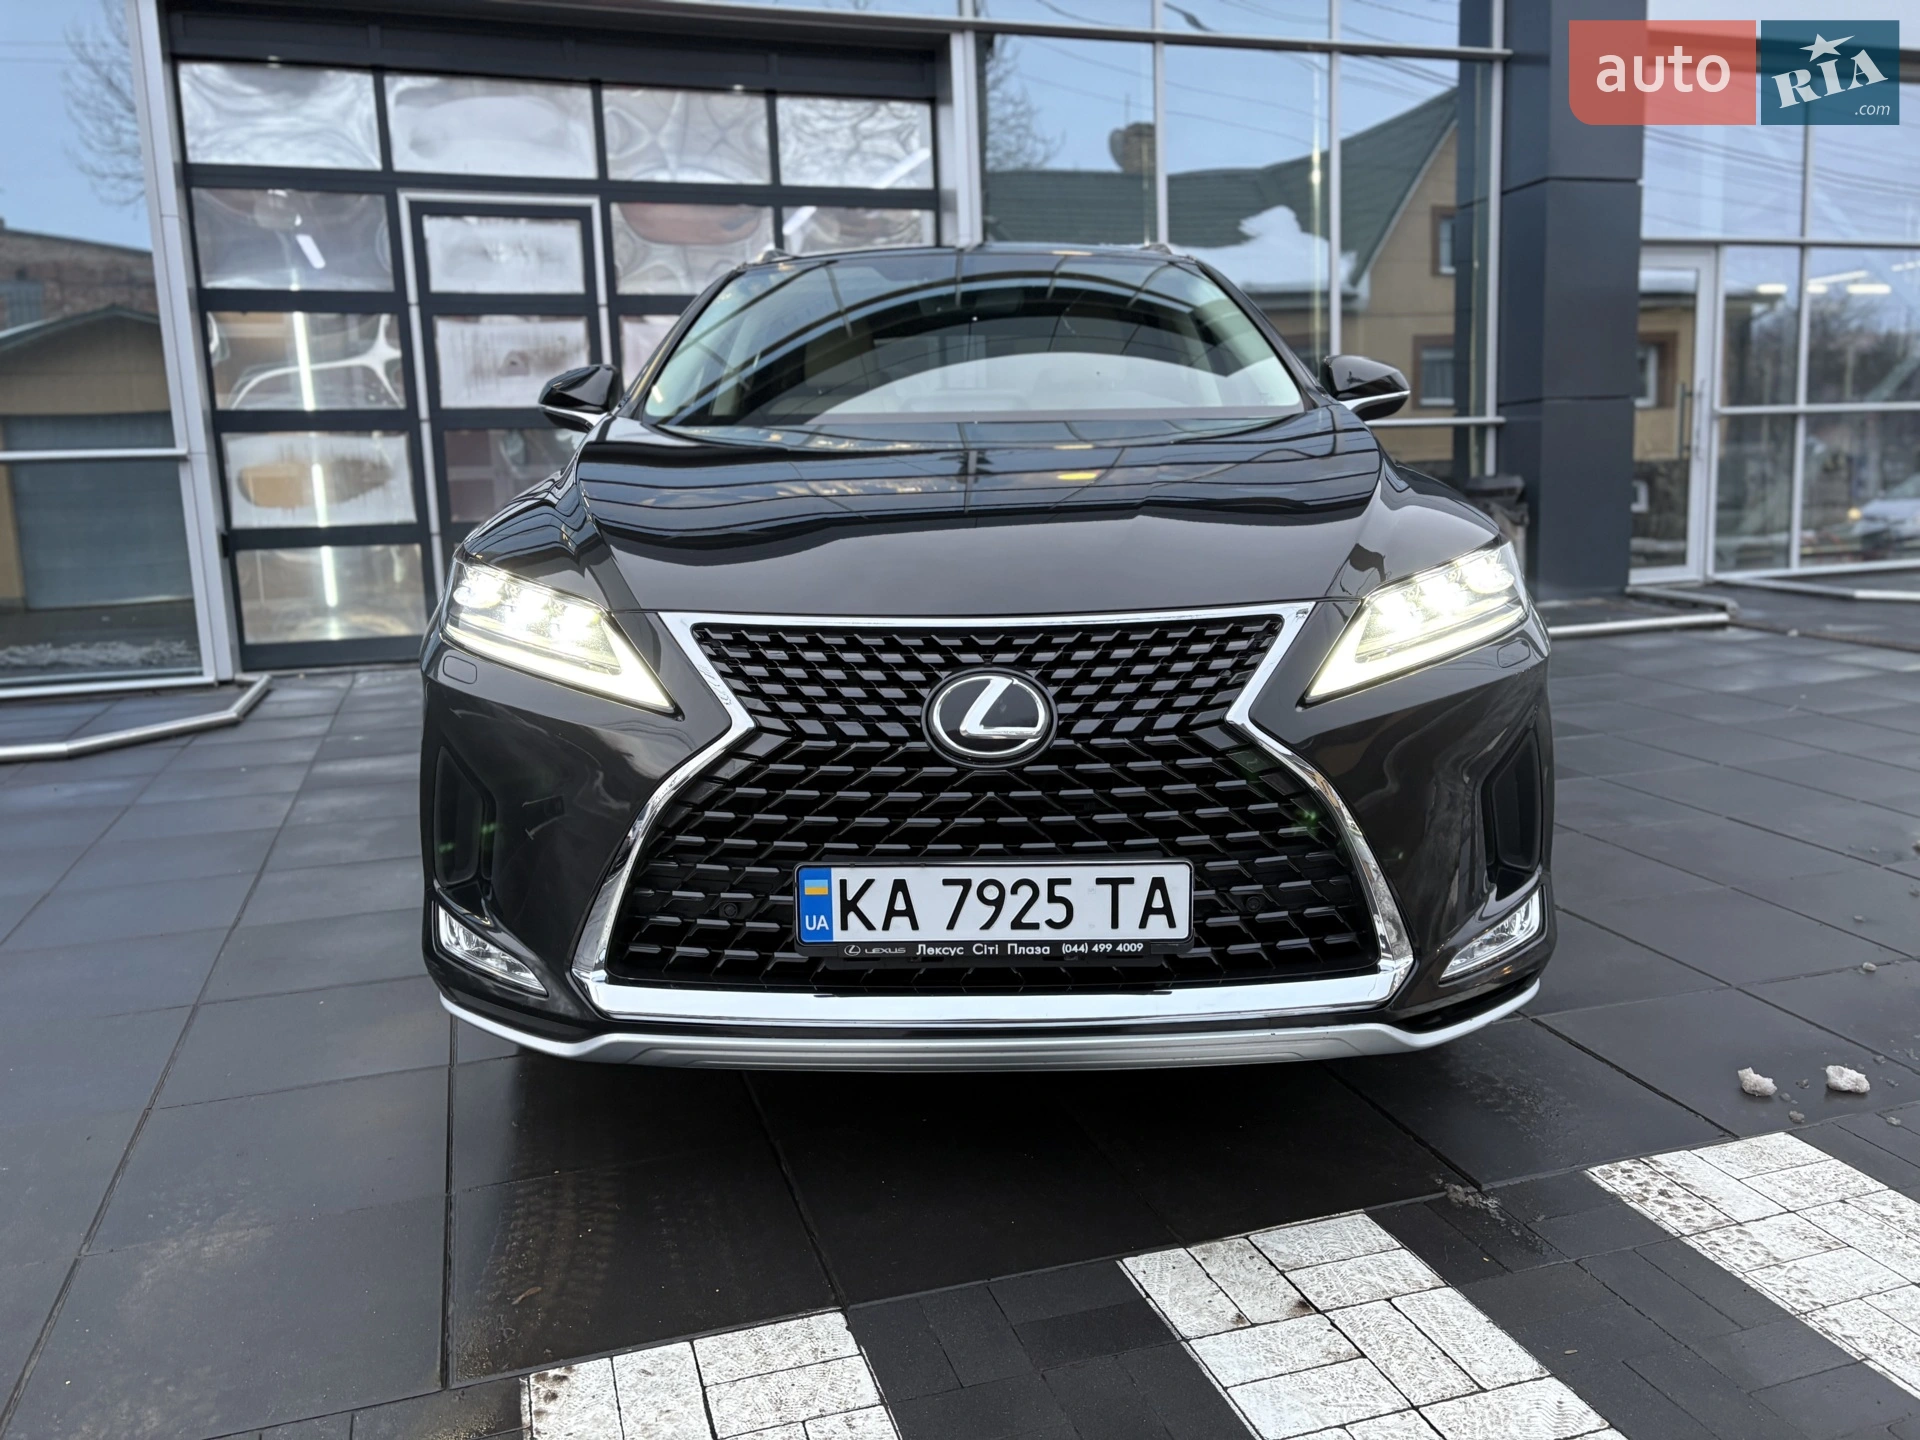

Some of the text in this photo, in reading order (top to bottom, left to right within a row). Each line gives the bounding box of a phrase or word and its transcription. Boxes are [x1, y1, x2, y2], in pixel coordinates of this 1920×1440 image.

[839, 876, 1177, 932] KA 7925 TA
[805, 914, 829, 930] UA
[916, 942, 1144, 956] Лексус Сіті Плаза (044) 499 4009
